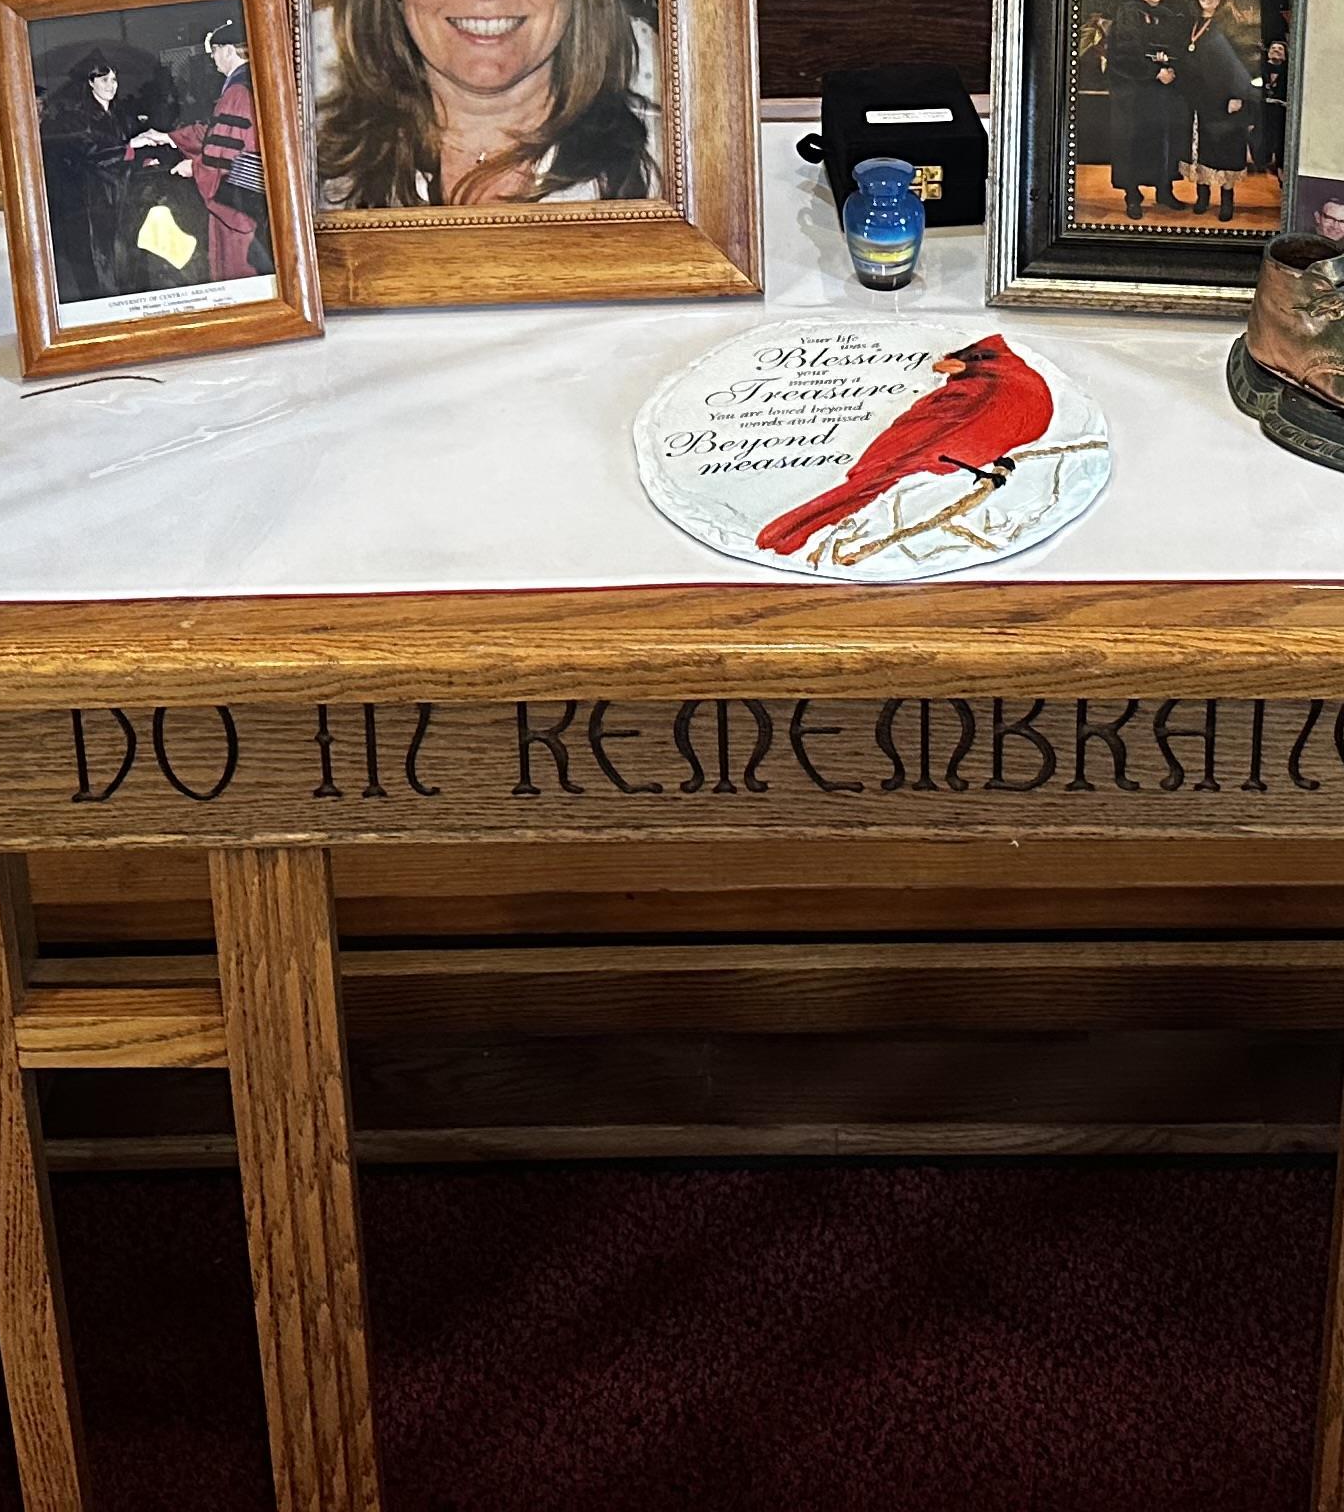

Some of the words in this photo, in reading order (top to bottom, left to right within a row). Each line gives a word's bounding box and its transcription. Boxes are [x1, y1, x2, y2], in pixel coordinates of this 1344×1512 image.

[836, 334, 858, 344] life
[754, 346, 932, 371] Blessing
[789, 378, 847, 386] memory
[709, 412, 735, 421] You
[739, 410, 763, 419] are
[768, 405, 806, 415] loved
[810, 400, 864, 414] beyond
[740, 417, 782, 428] words
[786, 415, 817, 426] and
[821, 411, 872, 423] missed
[664, 424, 839, 460] Beyond
[698, 452, 853, 476] measure
